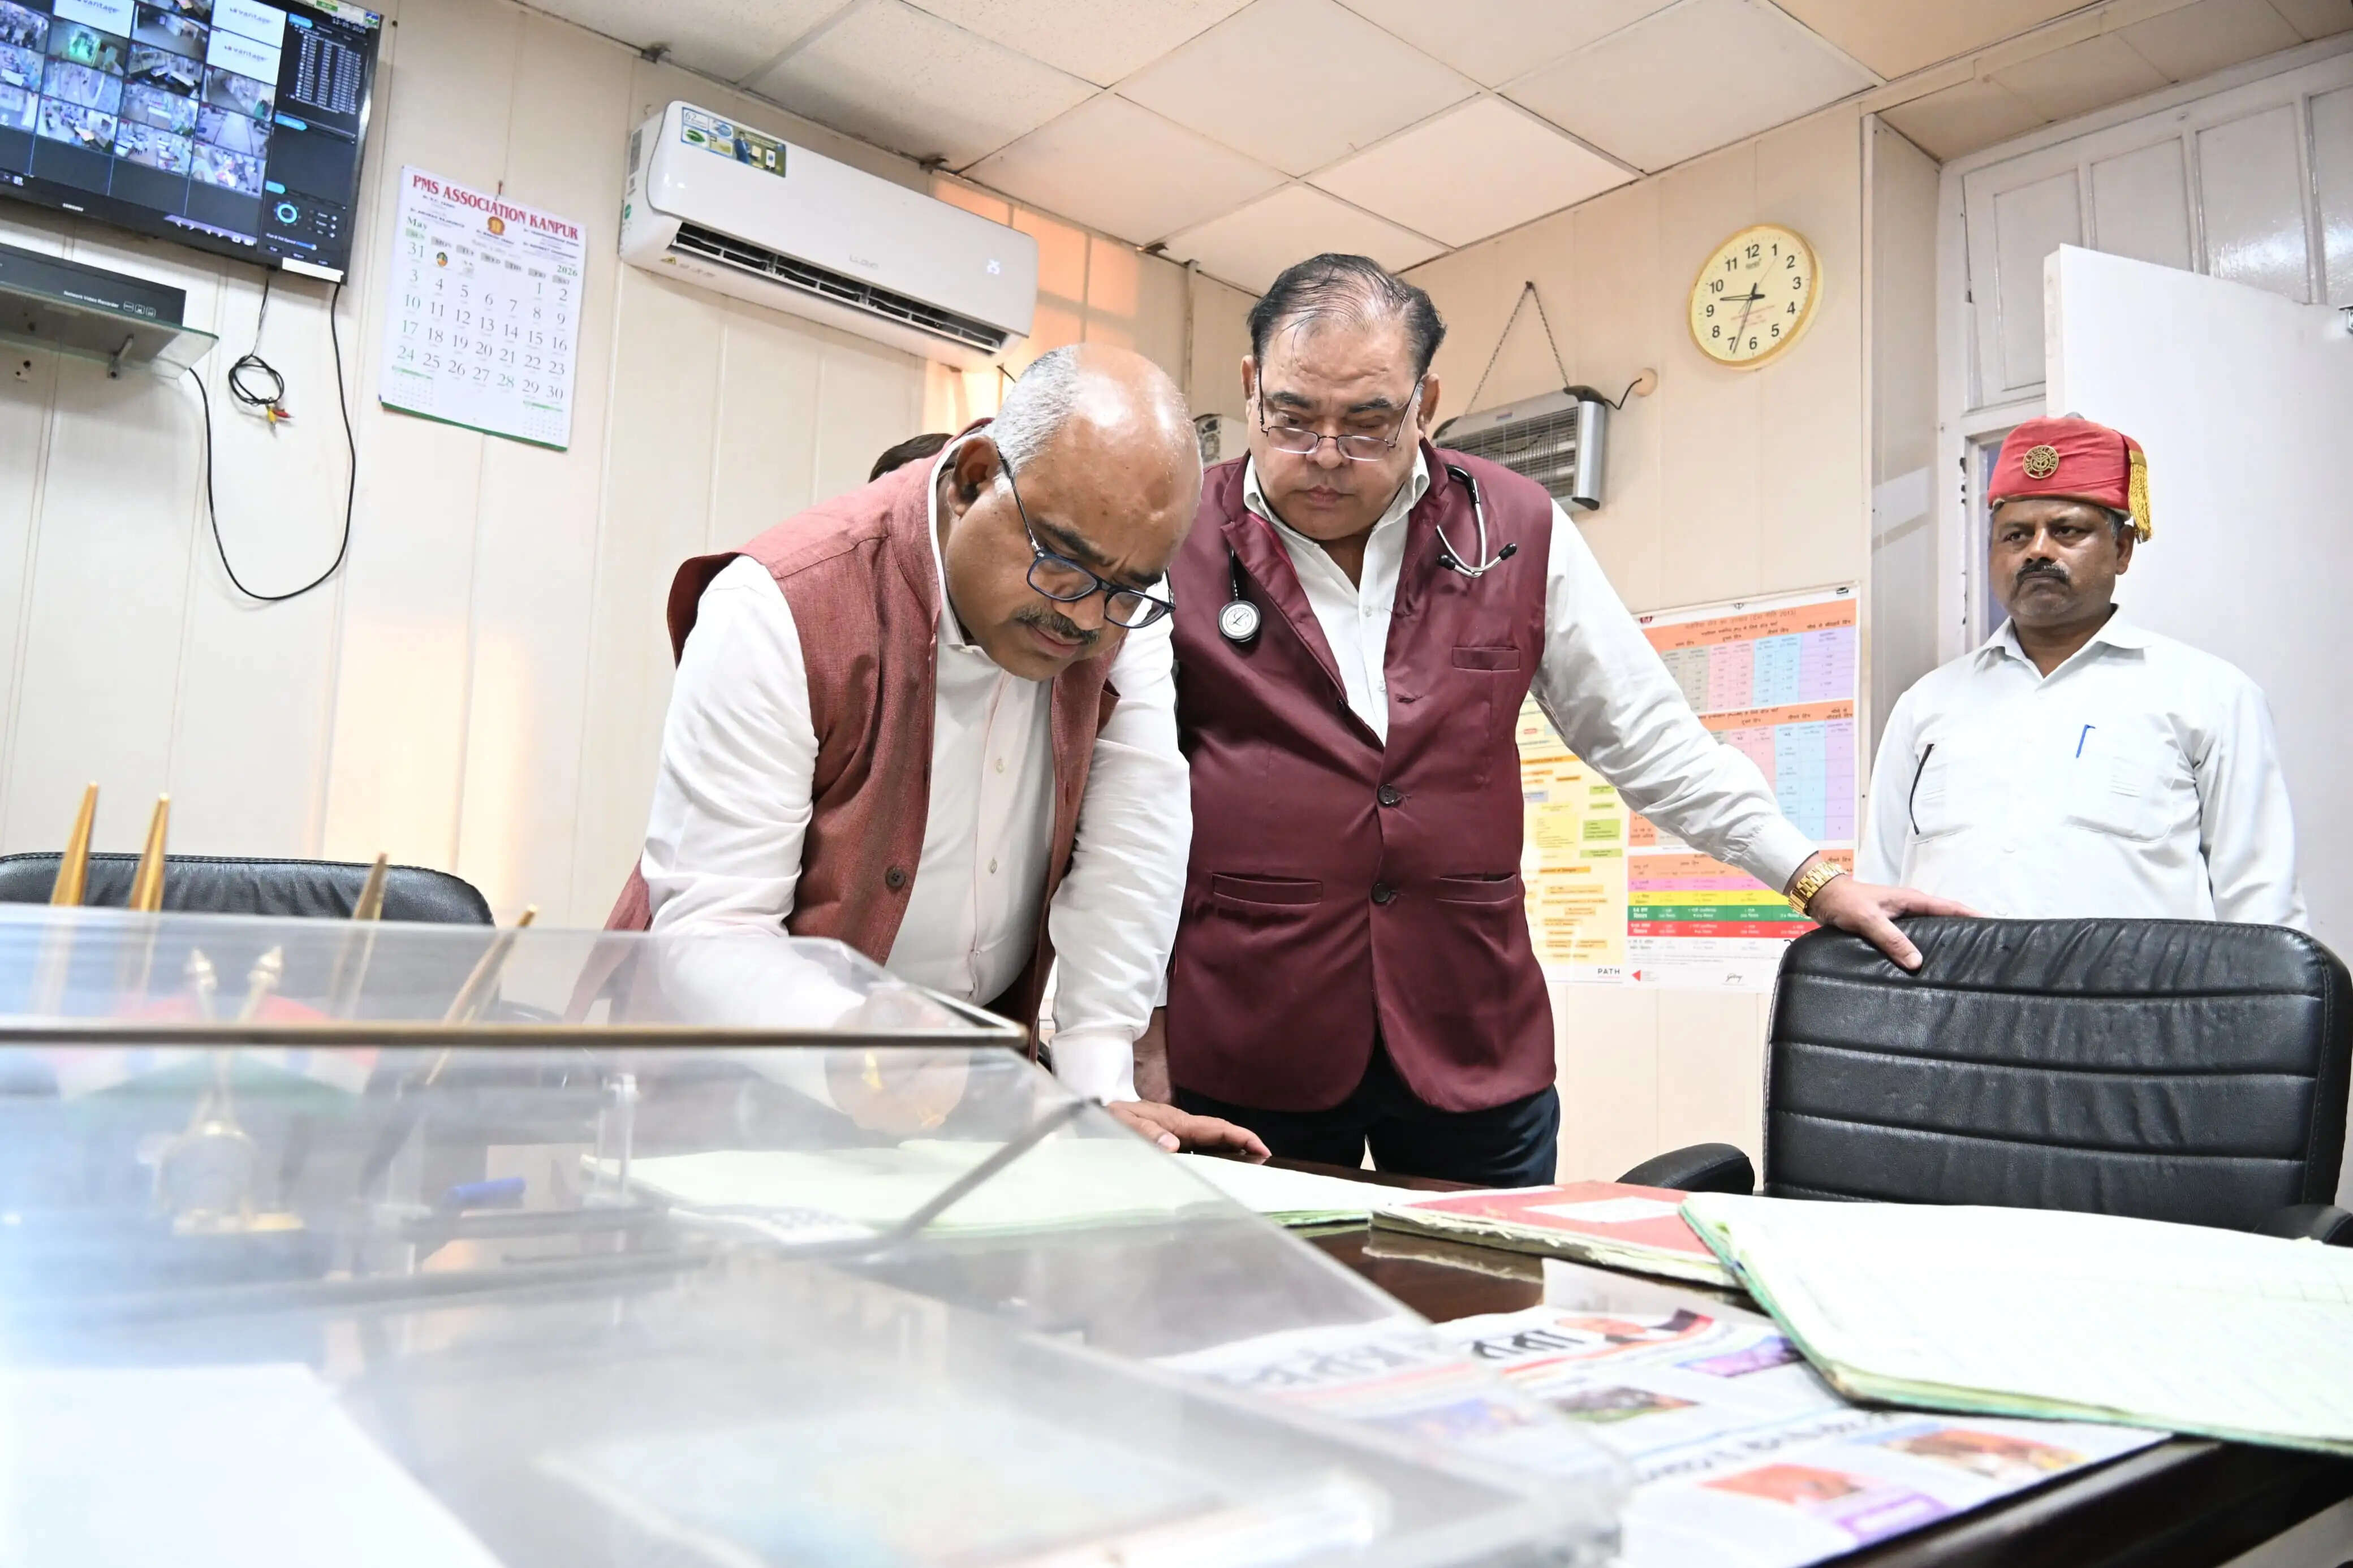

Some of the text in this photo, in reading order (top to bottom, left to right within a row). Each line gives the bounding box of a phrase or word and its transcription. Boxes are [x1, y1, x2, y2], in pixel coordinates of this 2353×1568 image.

[412, 175, 439, 195] PMS
[443, 186, 527, 224] ASSOCIATION
[529, 214, 579, 240] KANPUR
[407, 216, 428, 230] May
[1746, 244, 1760, 259] 12
[1772, 243, 1777, 256] 1
[1725, 257, 1737, 271] 11
[1786, 255, 1795, 269] 2
[407, 242, 567, 301] 31 1 2
[557, 265, 578, 277] 2026
[1709, 279, 1724, 293] 10
[1792, 276, 1802, 290] 3
[409, 269, 566, 325] 3 4 5 6 7 8 9
[1706, 304, 1714, 317] 9
[1787, 301, 1796, 314] 4
[405, 294, 567, 351] 10 11 12 13 14 15 16
[1712, 325, 1720, 338] 8
[1771, 323, 1779, 337] 5
[403, 320, 564, 375] 17 18 19 20 21 22 23
[1727, 336, 1736, 350] 7
[1749, 336, 1757, 349] 6
[397, 345, 563, 399] 24 25 26 27 28 29 30
